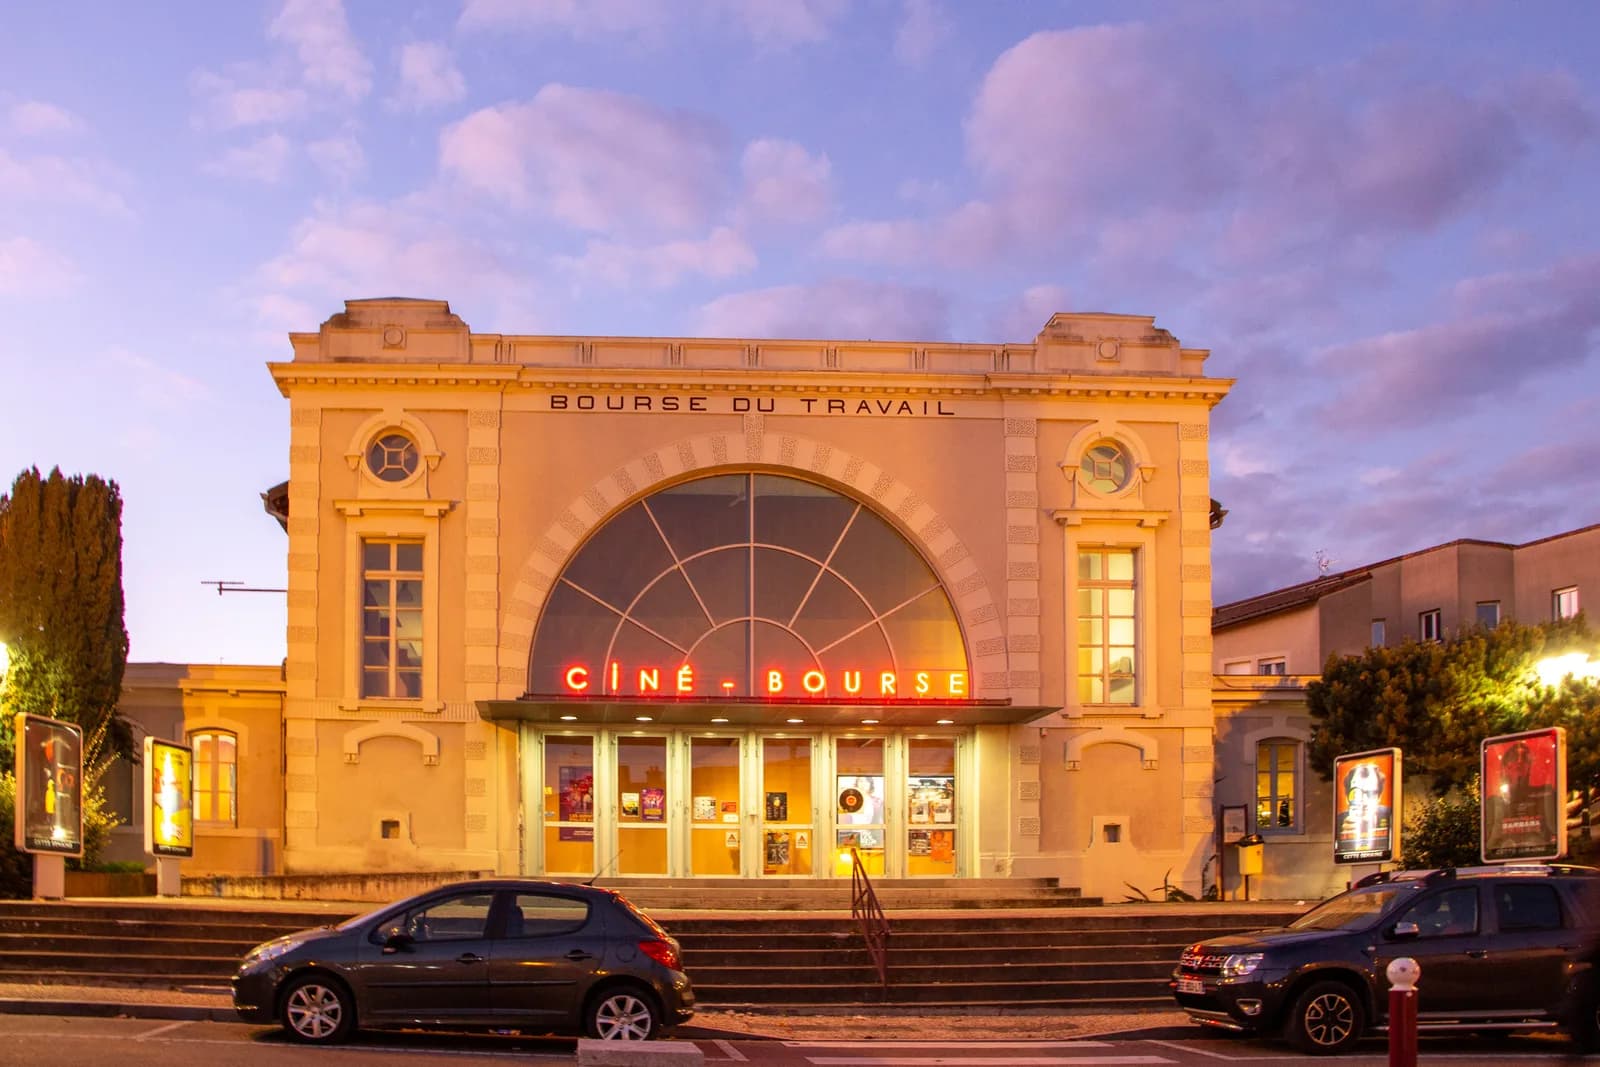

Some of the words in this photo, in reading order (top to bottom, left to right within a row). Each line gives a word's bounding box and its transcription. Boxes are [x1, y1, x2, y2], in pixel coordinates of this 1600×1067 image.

[551, 395, 707, 413] BOURSE
[733, 397, 775, 413] DU
[801, 398, 956, 415] TRAVAIL
[566, 662, 693, 692] CINÉ
[768, 669, 964, 695] BOURSE
